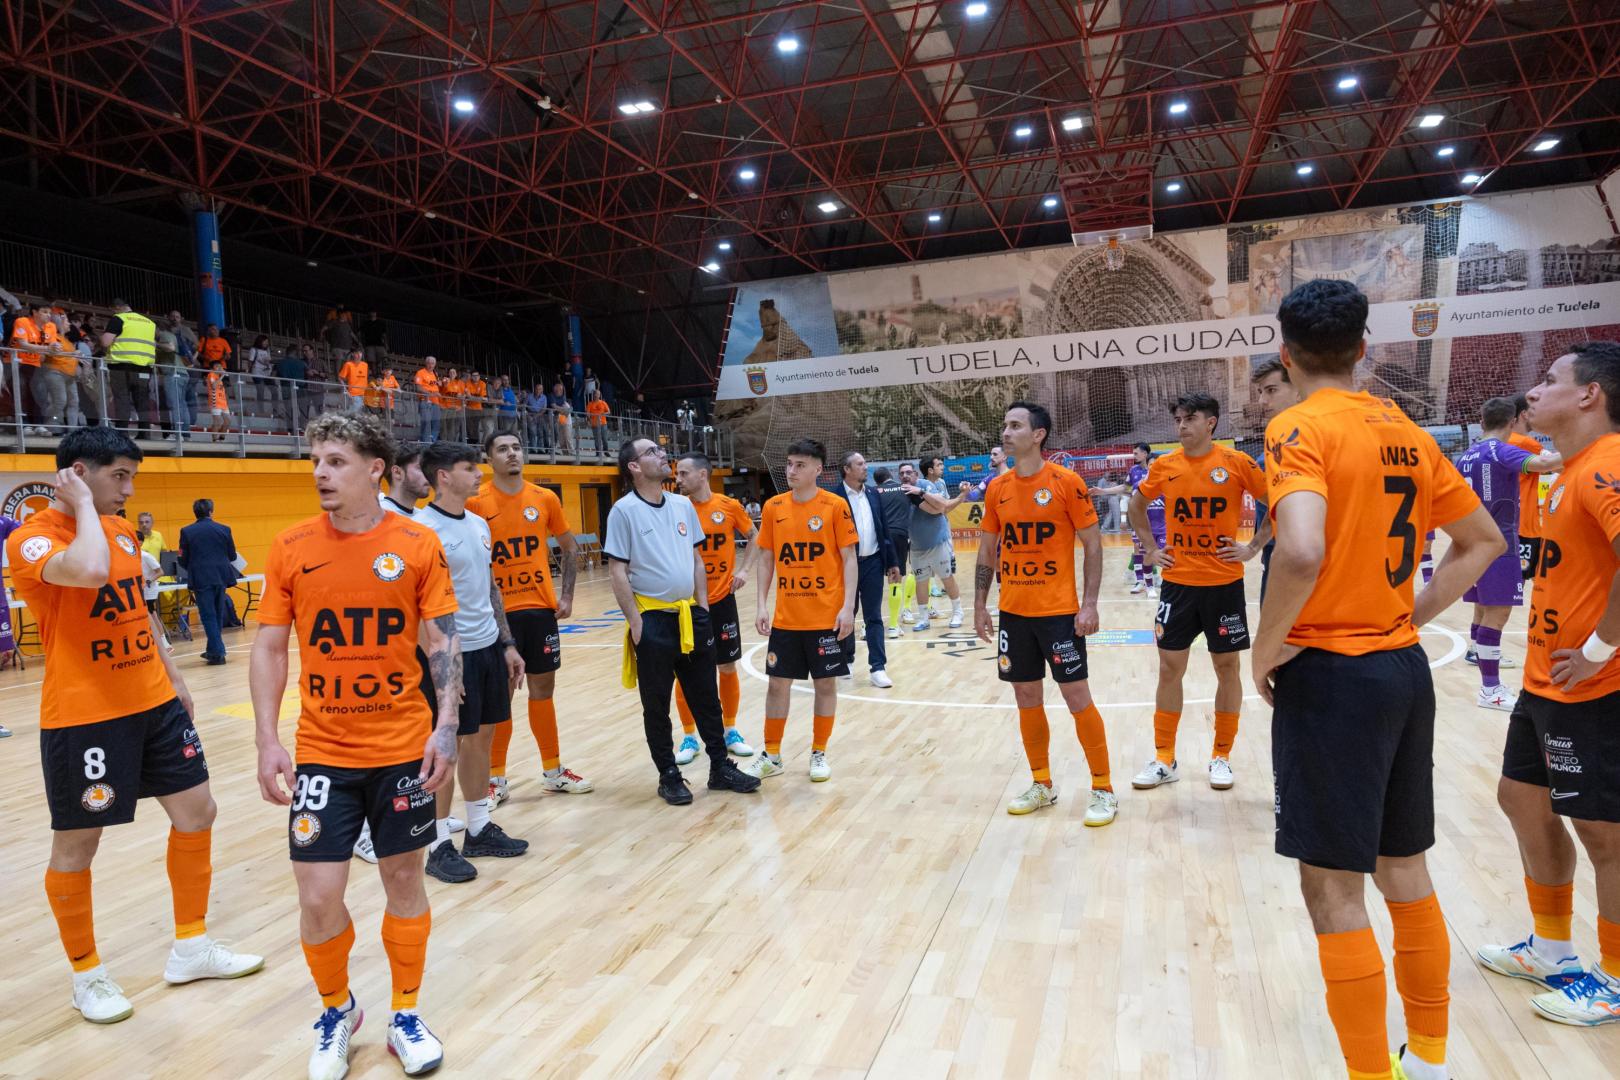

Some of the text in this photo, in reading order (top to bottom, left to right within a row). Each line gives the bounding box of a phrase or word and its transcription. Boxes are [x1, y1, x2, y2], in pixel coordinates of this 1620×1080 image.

[1450, 300, 1600, 324] Ayuntamiento de Tudela
[906, 325, 1276, 376] TUDELA, UNA CIUDAD
[775, 364, 880, 384] Ayuntamiento de Tudela
[1173, 496, 1227, 523] ATP
[1002, 522, 1056, 549] ATP
[1384, 476, 1418, 589] 3
[491, 535, 540, 564] ATP
[779, 542, 825, 565] ATP
[1156, 601, 1172, 624] 21
[309, 607, 406, 654] ATP
[320, 703, 393, 715] renovables
[83, 747, 106, 780] 8
[1550, 754, 1578, 765] MATEO
[1550, 763, 1582, 773] MUÑOZ
[292, 774, 331, 811] 99
